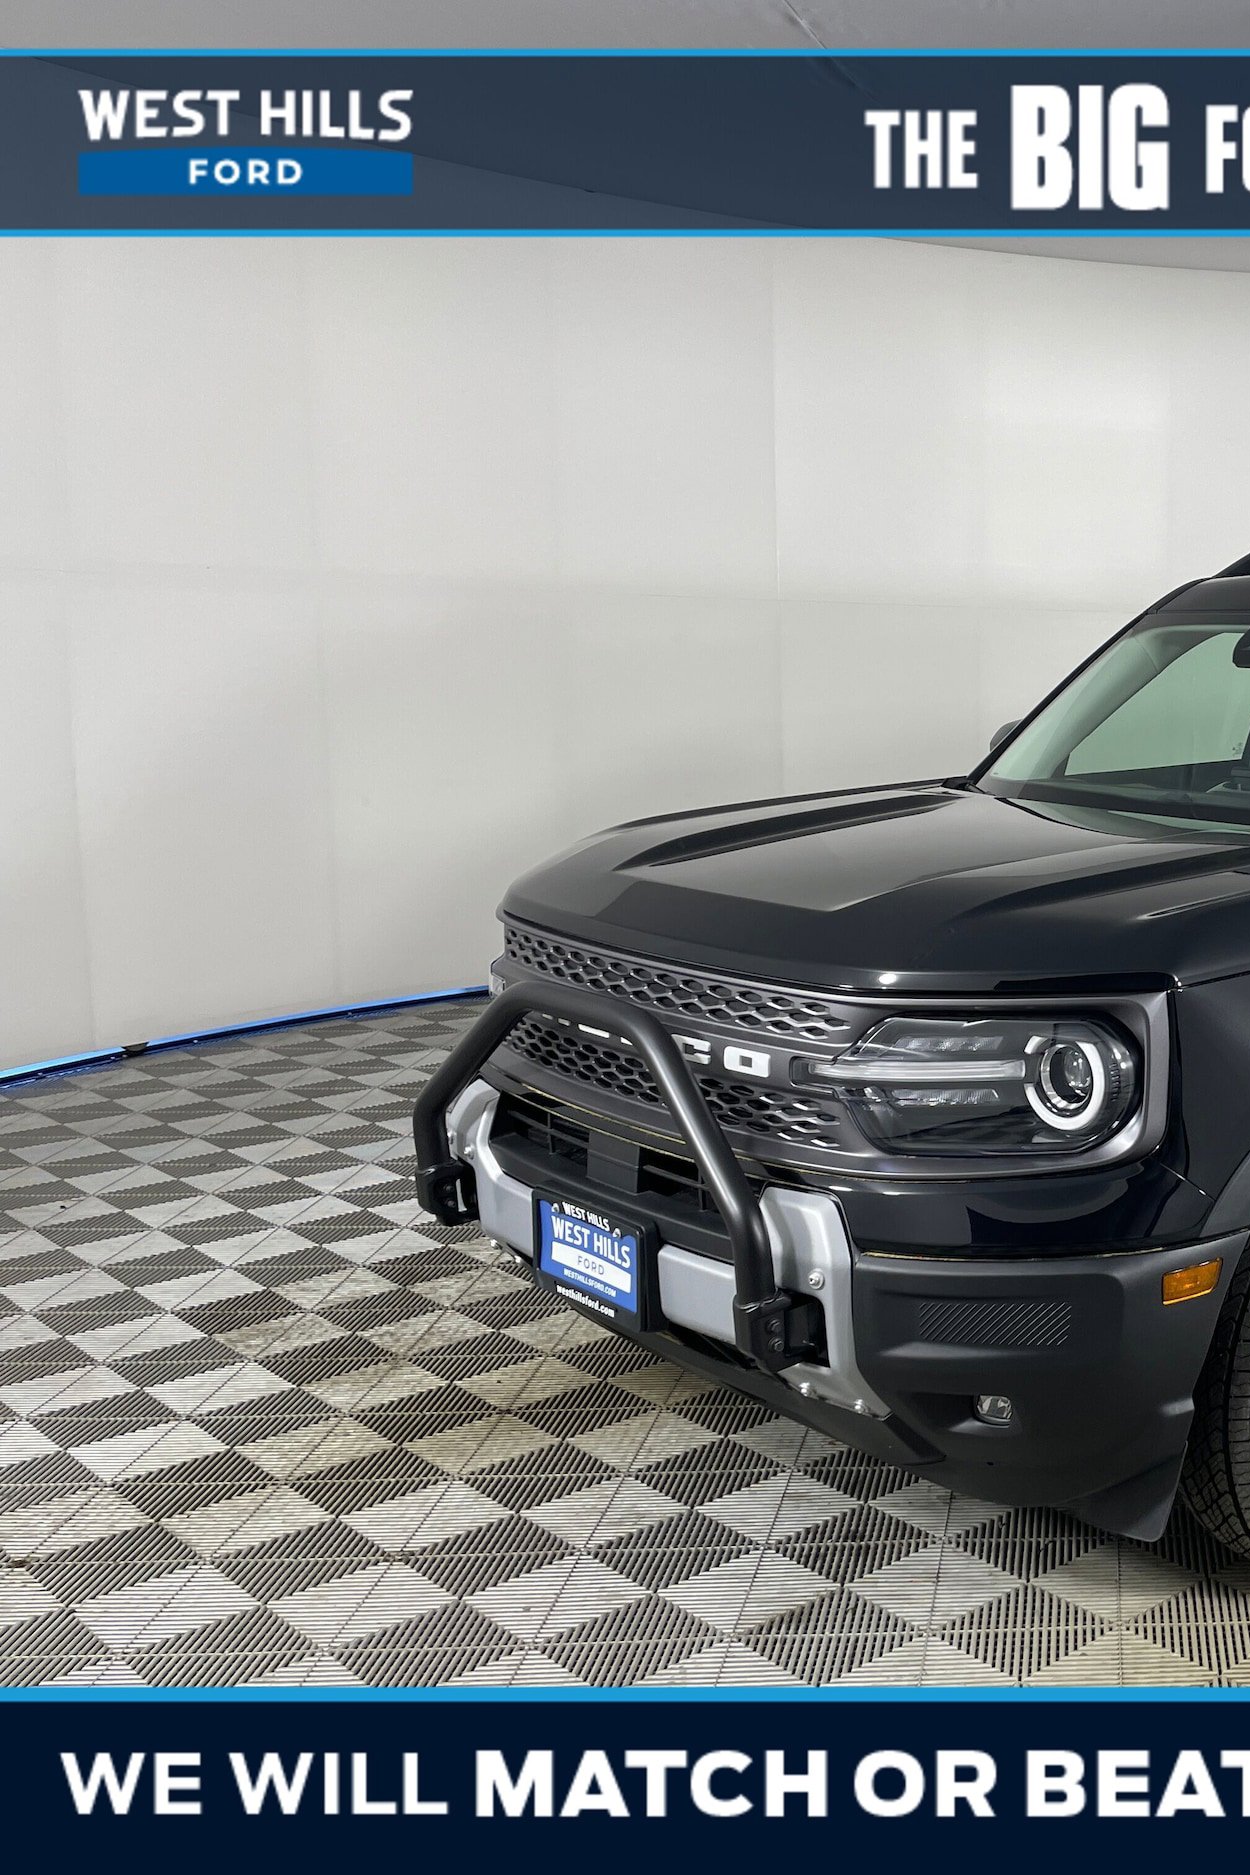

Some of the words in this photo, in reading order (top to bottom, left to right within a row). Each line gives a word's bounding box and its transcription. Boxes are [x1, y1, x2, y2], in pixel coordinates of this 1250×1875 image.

[562, 1201, 585, 1221] WEST
[587, 1211, 610, 1232] HILLS
[551, 1215, 591, 1249] WEST
[593, 1232, 631, 1269] HILLS
[577, 1255, 605, 1276] FORD
[563, 1267, 617, 1298] WESTHILLSFORD.COM
[556, 1284, 616, 1318] westhillsford.com
